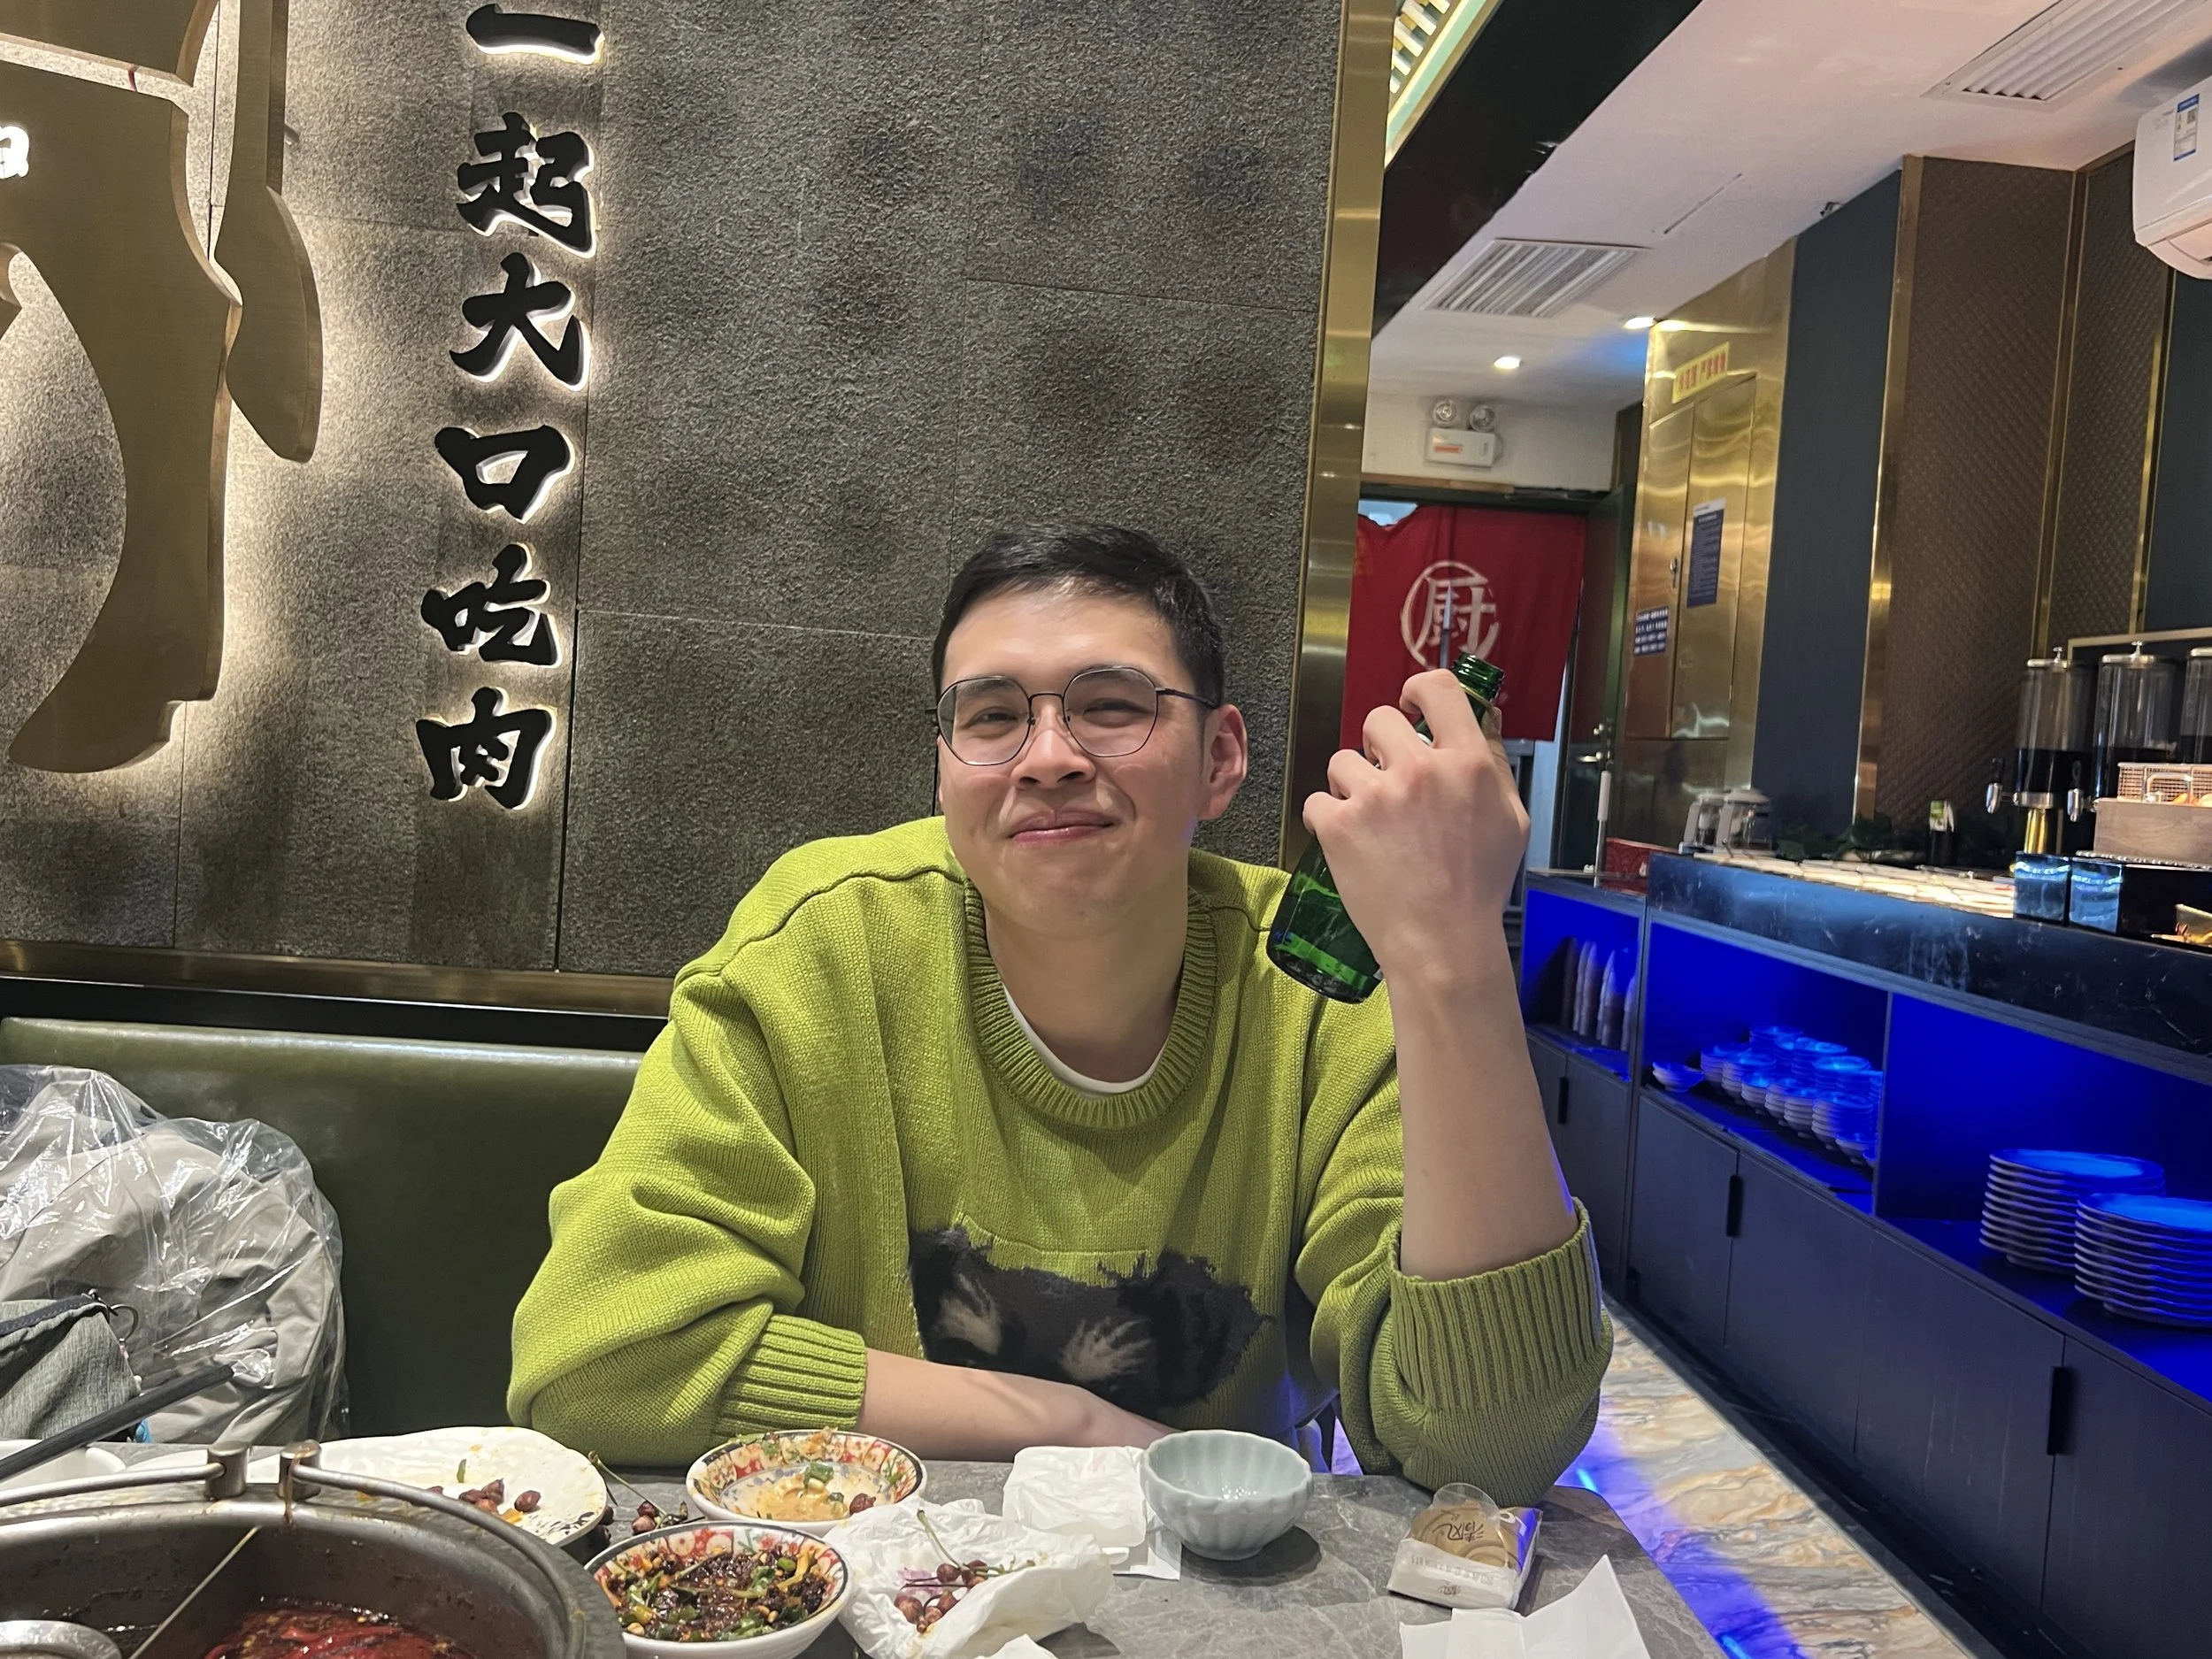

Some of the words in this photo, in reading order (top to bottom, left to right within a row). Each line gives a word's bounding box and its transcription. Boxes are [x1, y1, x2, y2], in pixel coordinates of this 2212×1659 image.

[416, 4, 602, 809] 一起大口吃肉
[1414, 576, 1497, 653] 厨
[1432, 1521, 1484, 1543] 清风
